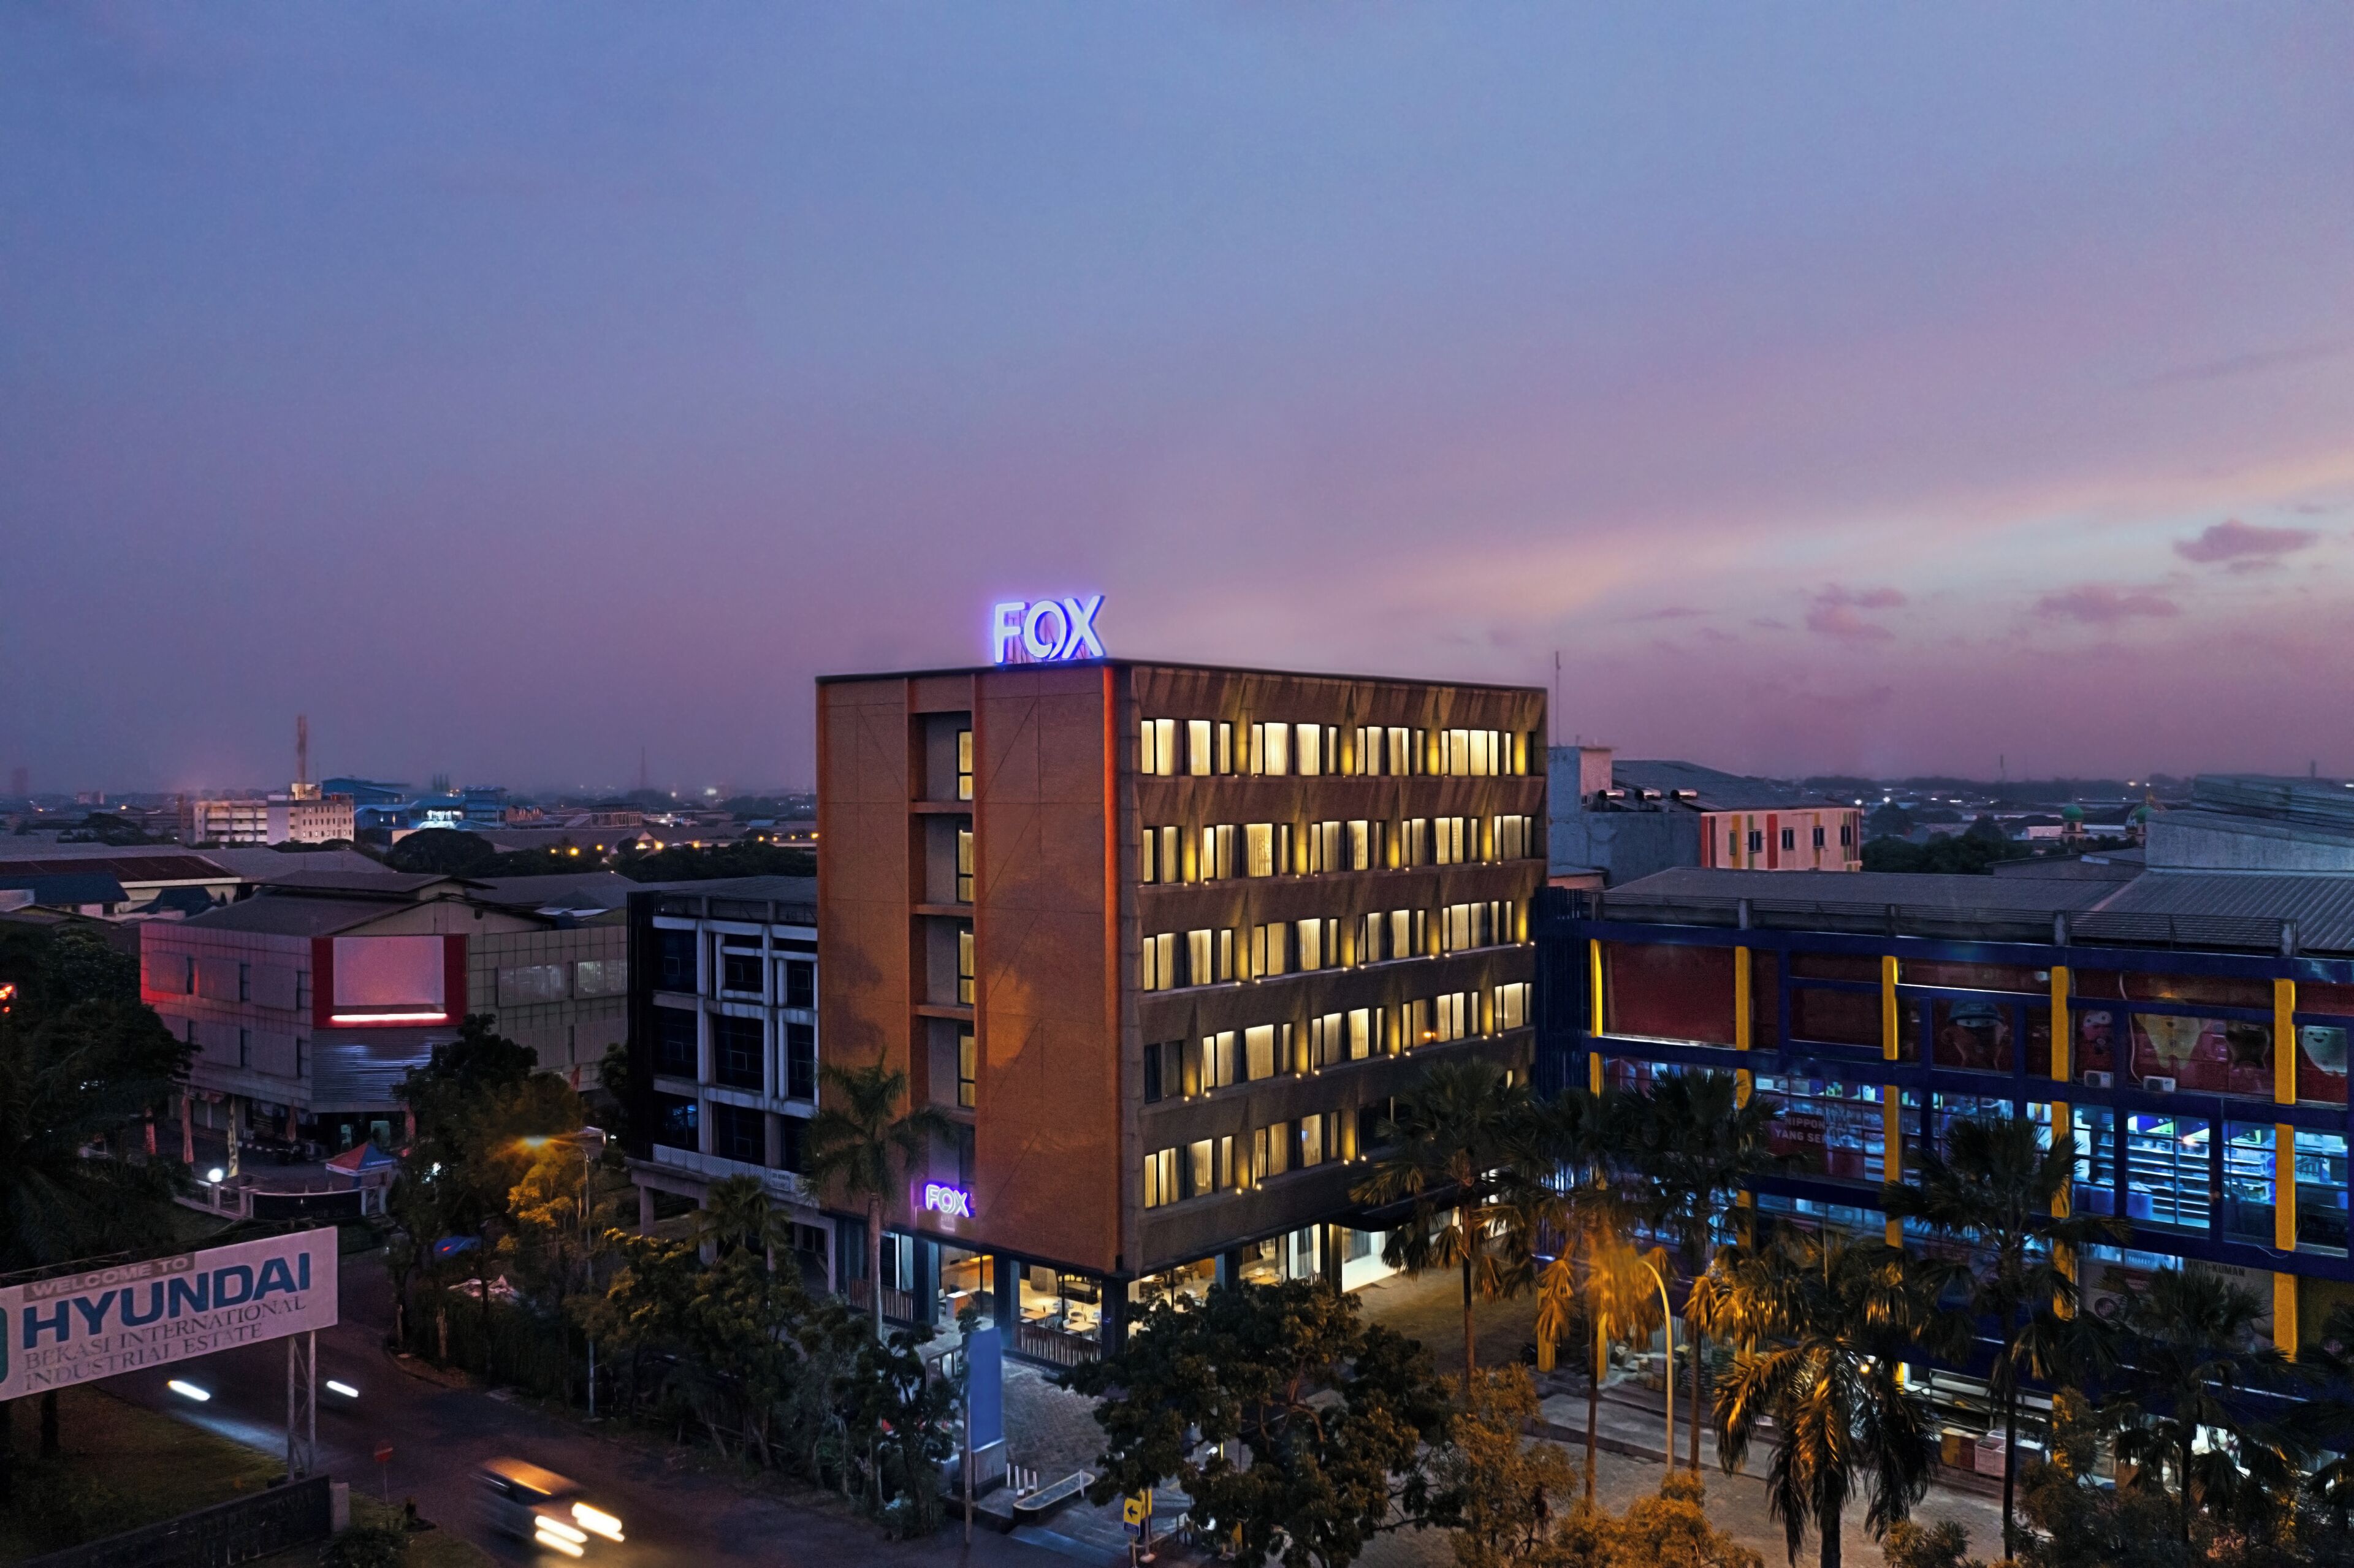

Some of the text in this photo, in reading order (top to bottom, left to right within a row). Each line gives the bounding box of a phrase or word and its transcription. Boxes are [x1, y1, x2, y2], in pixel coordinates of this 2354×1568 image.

[994, 595, 1105, 663] FOX
[1775, 1128, 1804, 1141] YANG
[1785, 1117, 1825, 1130] NIPPON
[926, 1184, 969, 1217] FOX
[23, 1252, 310, 1350] HYUNDAI
[32, 1257, 189, 1296] WELCOME TO
[25, 1296, 306, 1370] BEKASI INTERNATIONAL
[25, 1322, 262, 1390] INDUSTRIAL ESTATE
